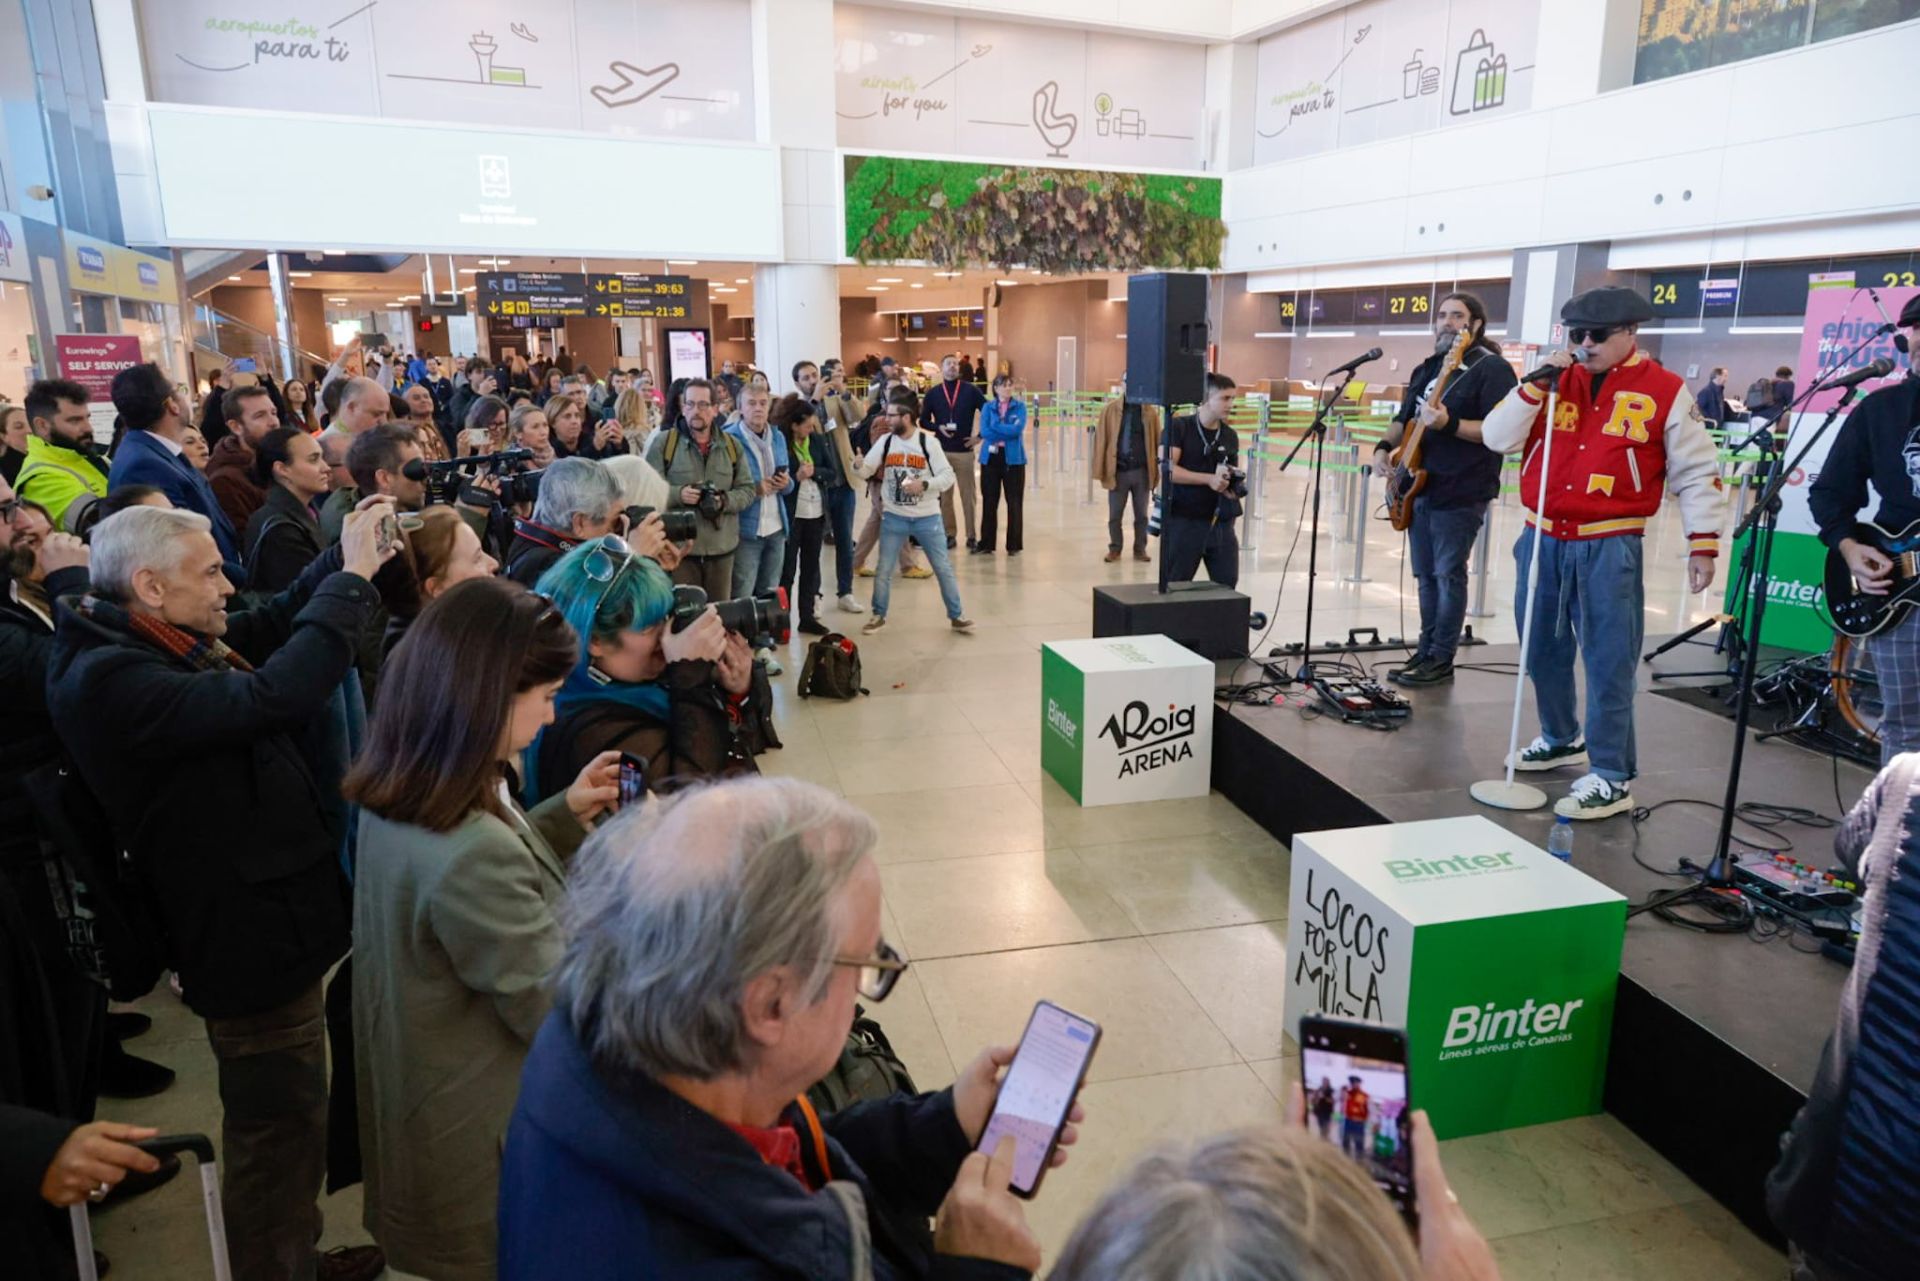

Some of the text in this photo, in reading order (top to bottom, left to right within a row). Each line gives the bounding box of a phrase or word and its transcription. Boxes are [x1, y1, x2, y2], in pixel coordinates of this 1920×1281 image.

[205, 17, 319, 38] aeropuertos
[254, 36, 350, 64] para ti
[882, 92, 948, 121] for you
[1288, 88, 1336, 126] para ti
[1390, 296, 1428, 314] 27 26
[1653, 284, 1677, 304] 24
[1281, 302, 1294, 316] 28
[65, 347, 108, 356] Eurowings
[68, 361, 92, 370] SELF
[1601, 391, 1657, 443] R
[1048, 697, 1077, 740] Binter
[1097, 700, 1195, 755] Roig
[1118, 741, 1193, 779] ARENA
[1383, 851, 1513, 879] Binter
[1306, 868, 1389, 975] LOCOS
[1304, 920, 1384, 1022] POR LA
[1442, 998, 1584, 1048] Binter
[1512, 1038, 1526, 1050] de
[1528, 1032, 1574, 1047] Canarias
